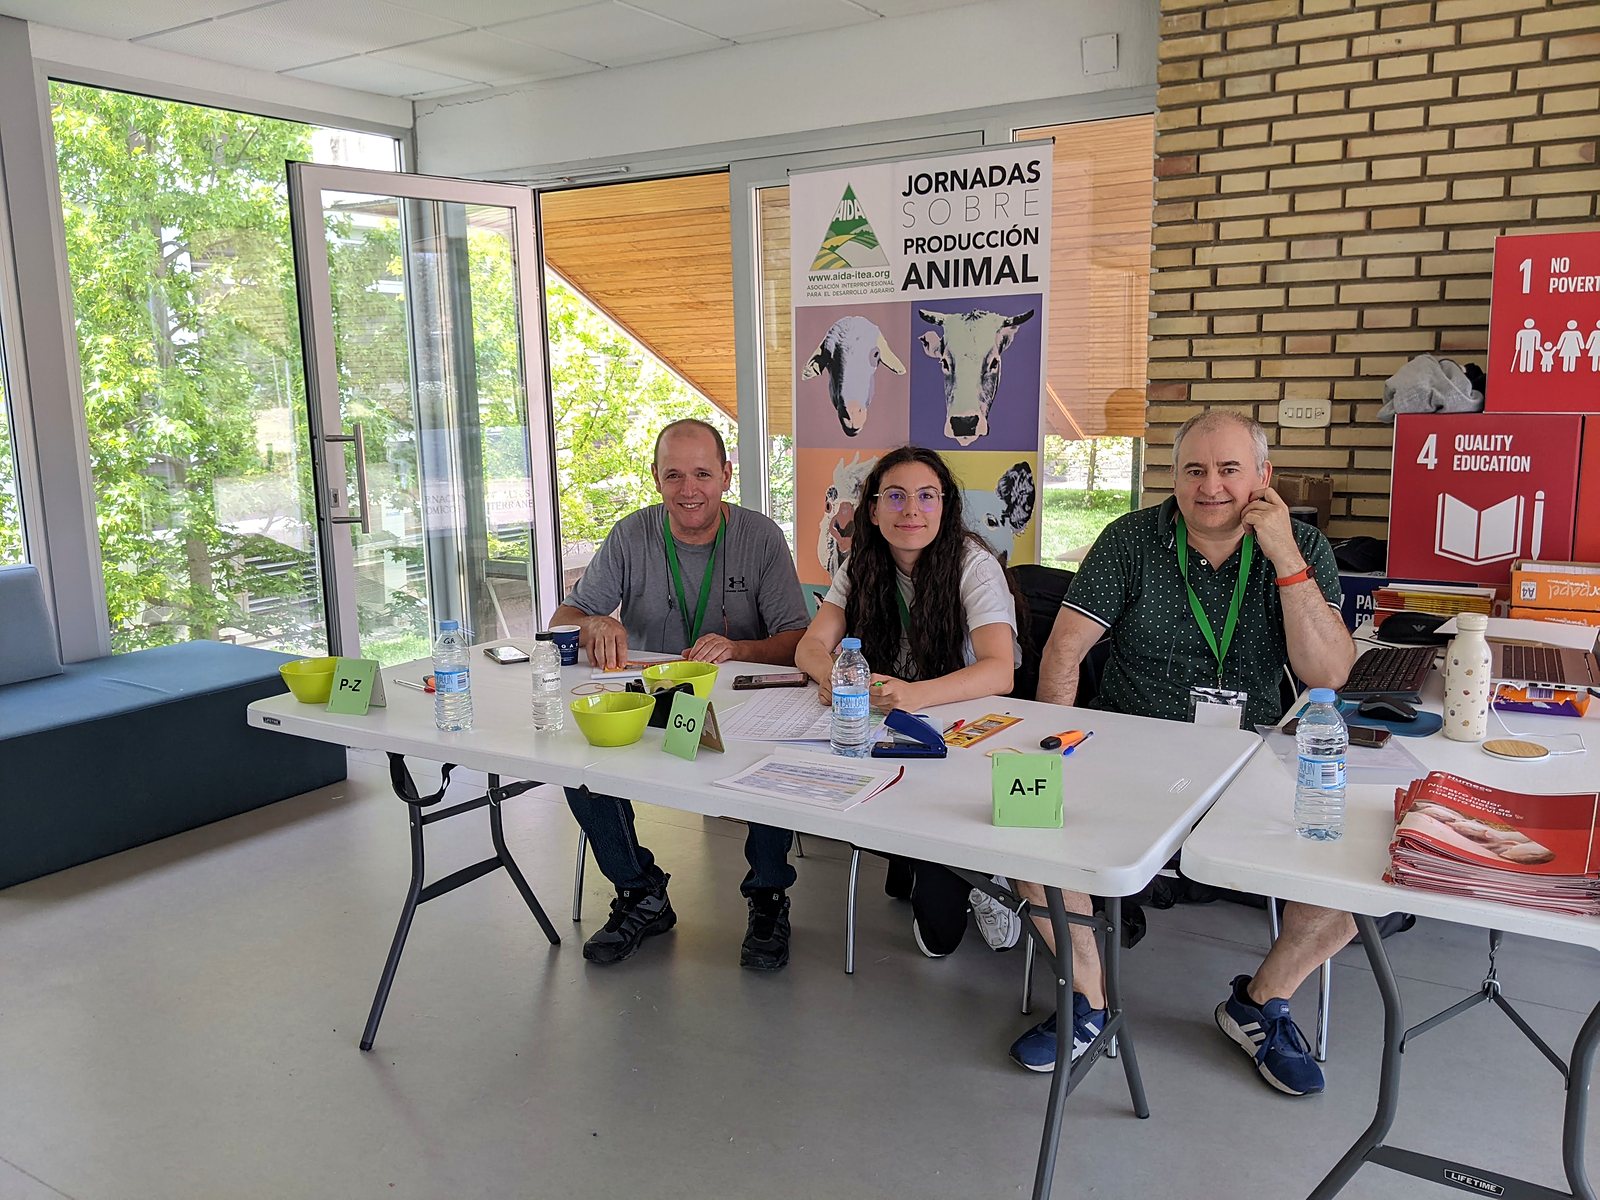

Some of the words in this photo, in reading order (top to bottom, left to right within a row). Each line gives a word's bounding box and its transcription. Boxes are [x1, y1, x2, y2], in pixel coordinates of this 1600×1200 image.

[901, 160, 1041, 197] JORNADAS
[832, 199, 867, 222] AIDA
[902, 188, 1040, 228] SOBRE
[903, 224, 1040, 256] PRODUCCIÓN
[901, 253, 1039, 292] ANIMAL
[1550, 256, 1570, 274] NO
[808, 269, 891, 282] www.aida-itea.org
[1519, 258, 1532, 294] 1
[807, 283, 840, 291] ASOCIACIÓN
[841, 280, 895, 289] INTERPROFESIONAL
[833, 288, 868, 296] DESARROLLO
[1416, 433, 1438, 470] 4
[1454, 434, 1514, 452] QUALITY
[1452, 454, 1531, 473] EDUCATION
[1522, 588, 1535, 597] A4
[339, 678, 362, 692] P-Z
[673, 713, 696, 733] G-O
[1009, 778, 1047, 796] A-F
[1451, 1172, 1497, 1193] LIFETIME
